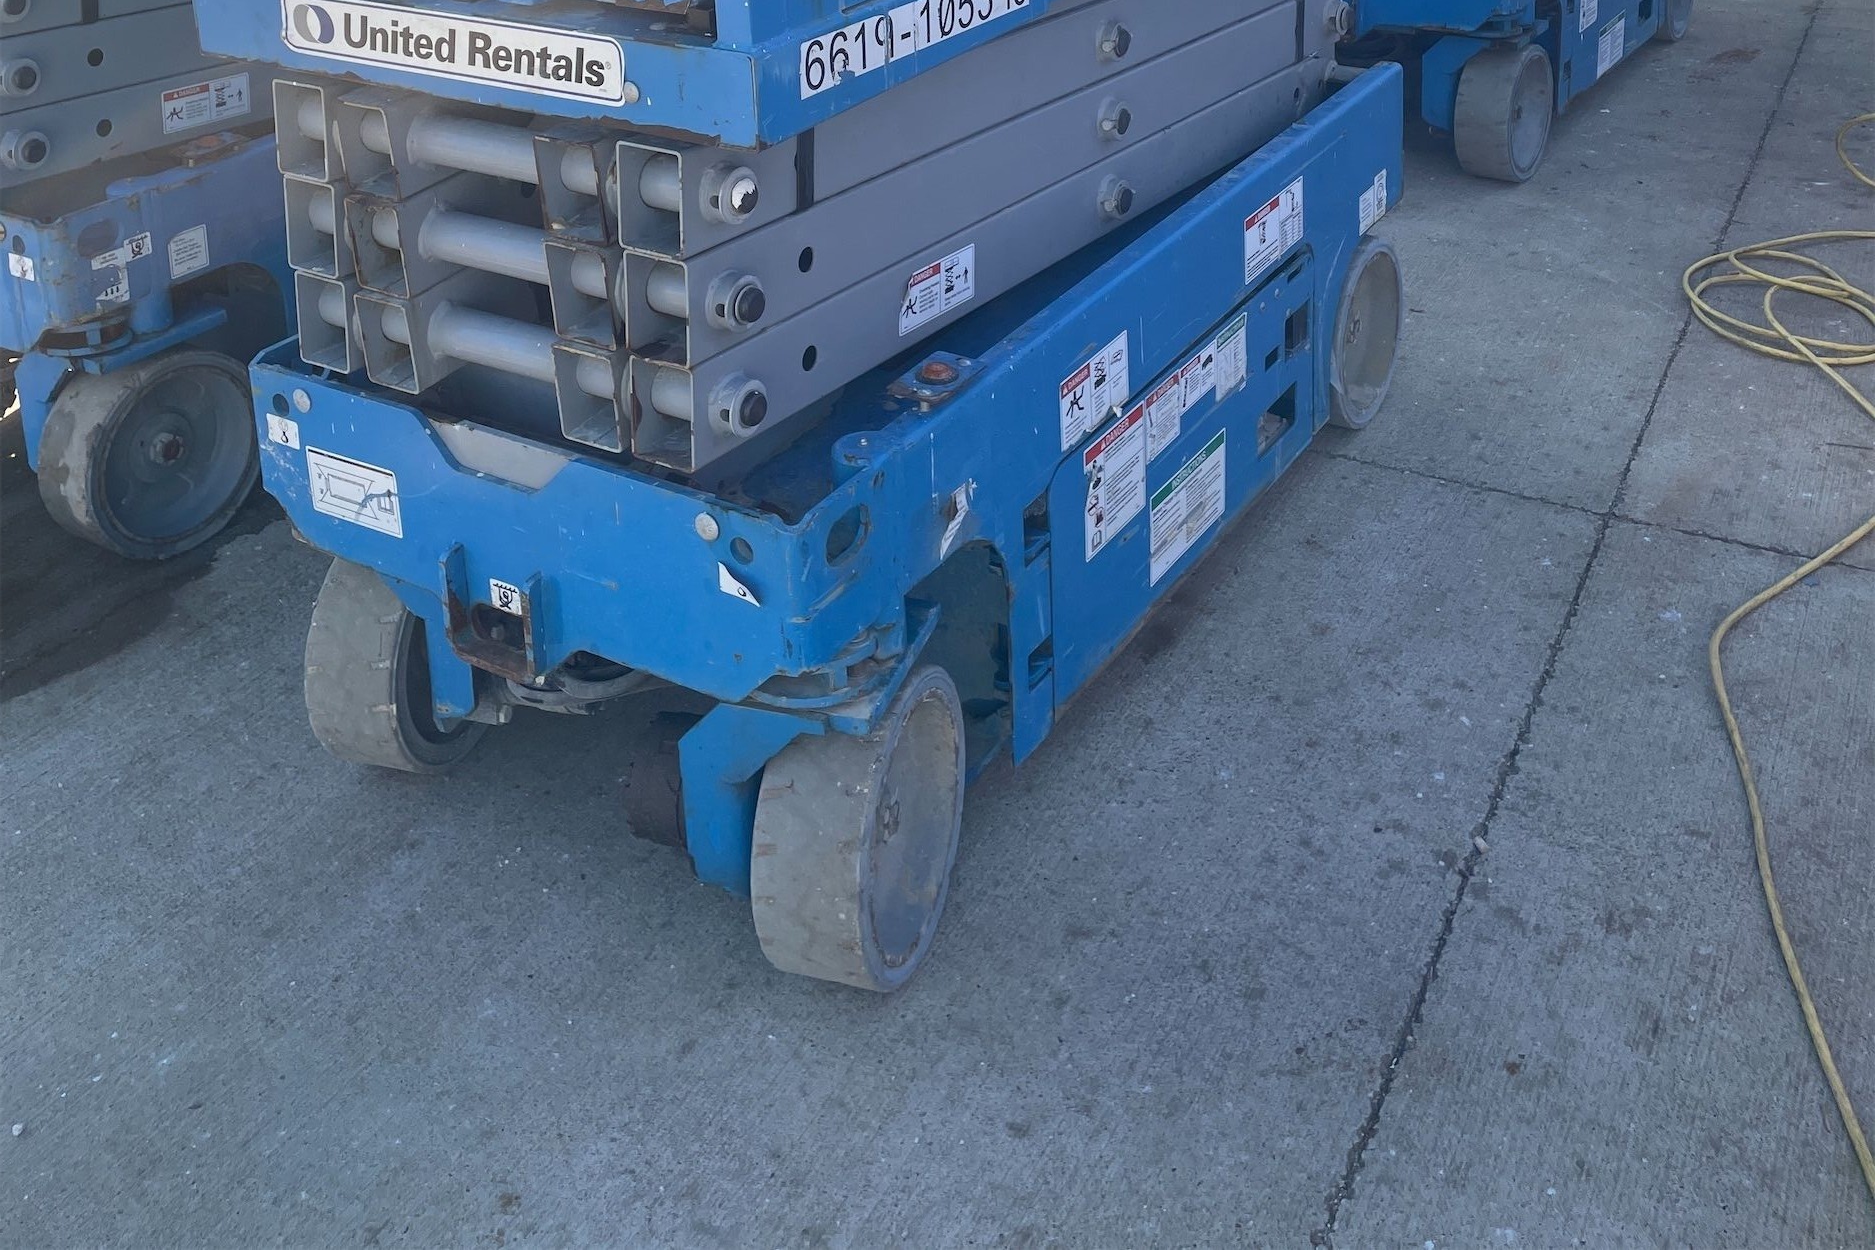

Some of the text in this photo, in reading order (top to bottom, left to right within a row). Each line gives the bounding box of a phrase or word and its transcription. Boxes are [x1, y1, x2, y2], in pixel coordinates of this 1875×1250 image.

[343, 12, 605, 87] United Rentals
[1105, 417, 1130, 446] DANGER
